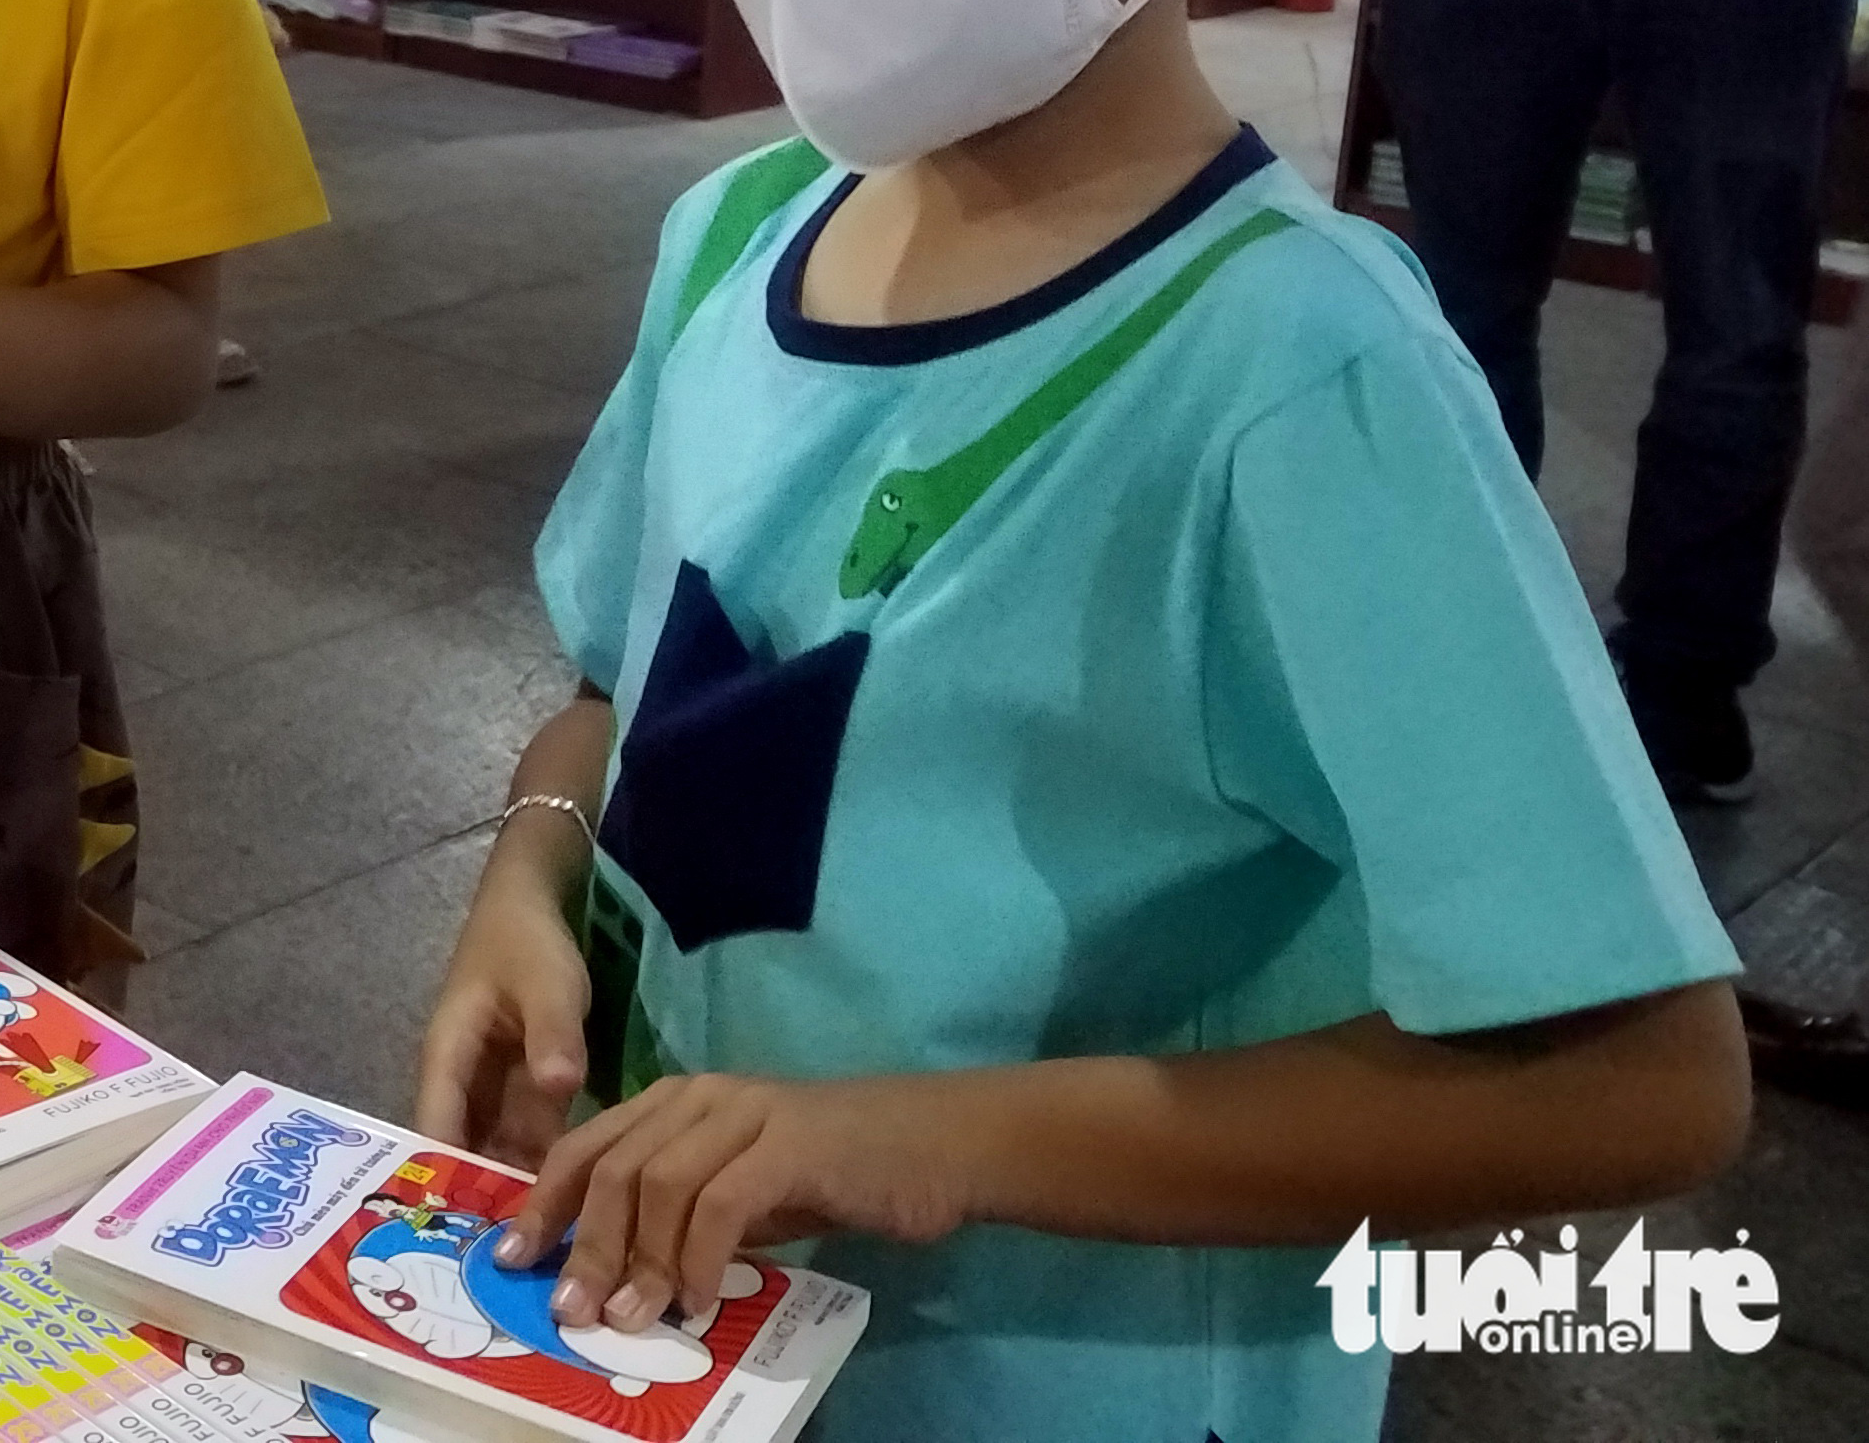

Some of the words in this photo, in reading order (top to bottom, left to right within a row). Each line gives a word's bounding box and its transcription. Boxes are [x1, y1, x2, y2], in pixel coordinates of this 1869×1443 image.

[43, 1090, 110, 1118] FUJIKO
[112, 1083, 124, 1094] F
[125, 1066, 178, 1089] FUJIO
[151, 1398, 215, 1441] FUJIO
[184, 1383, 248, 1425] FUJIO
